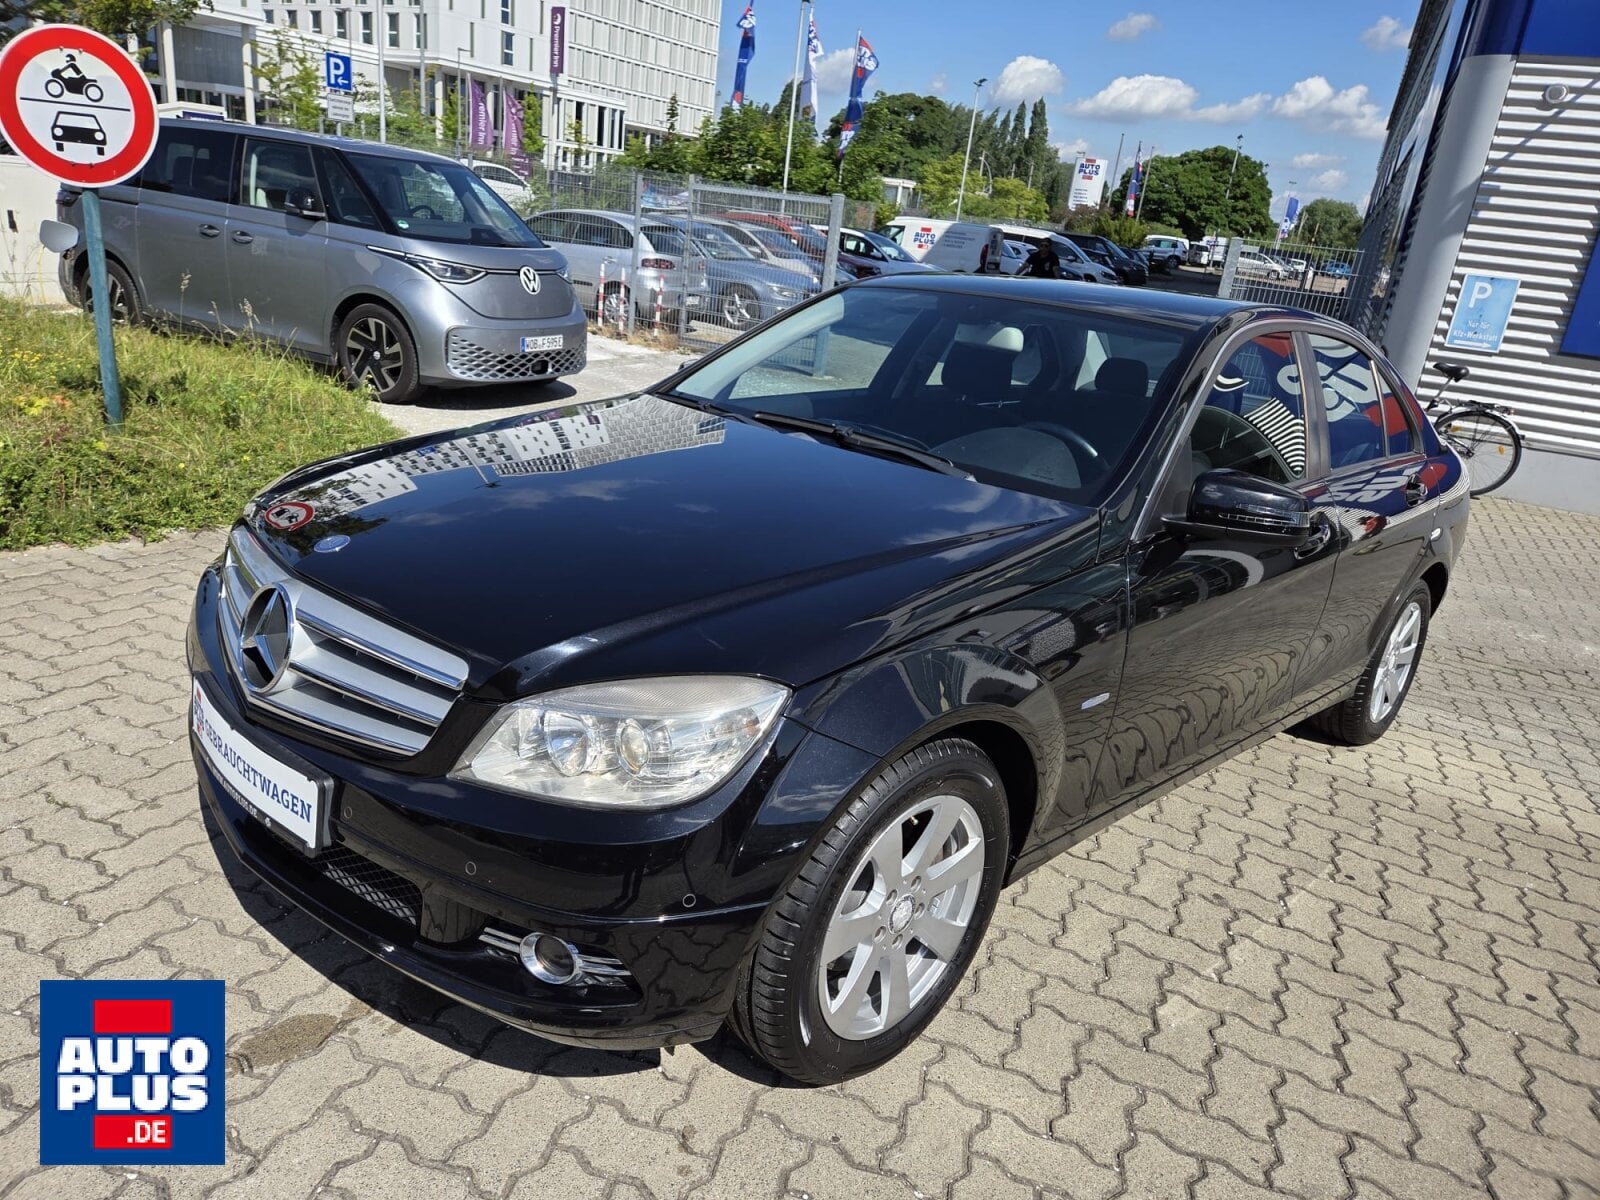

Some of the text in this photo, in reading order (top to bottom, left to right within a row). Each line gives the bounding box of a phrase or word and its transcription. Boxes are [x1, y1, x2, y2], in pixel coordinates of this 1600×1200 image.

[552, 25, 561, 67] Premier Inn
[329, 56, 345, 84] P
[477, 131, 486, 145] Inn
[1078, 168, 1100, 176] PLUS
[913, 237, 935, 245] PLUS
[914, 231, 936, 239] AUTO
[1468, 281, 1493, 308] P
[1467, 320, 1479, 329] Nur
[204, 719, 313, 824] GEBRAUCHTWAGEN
